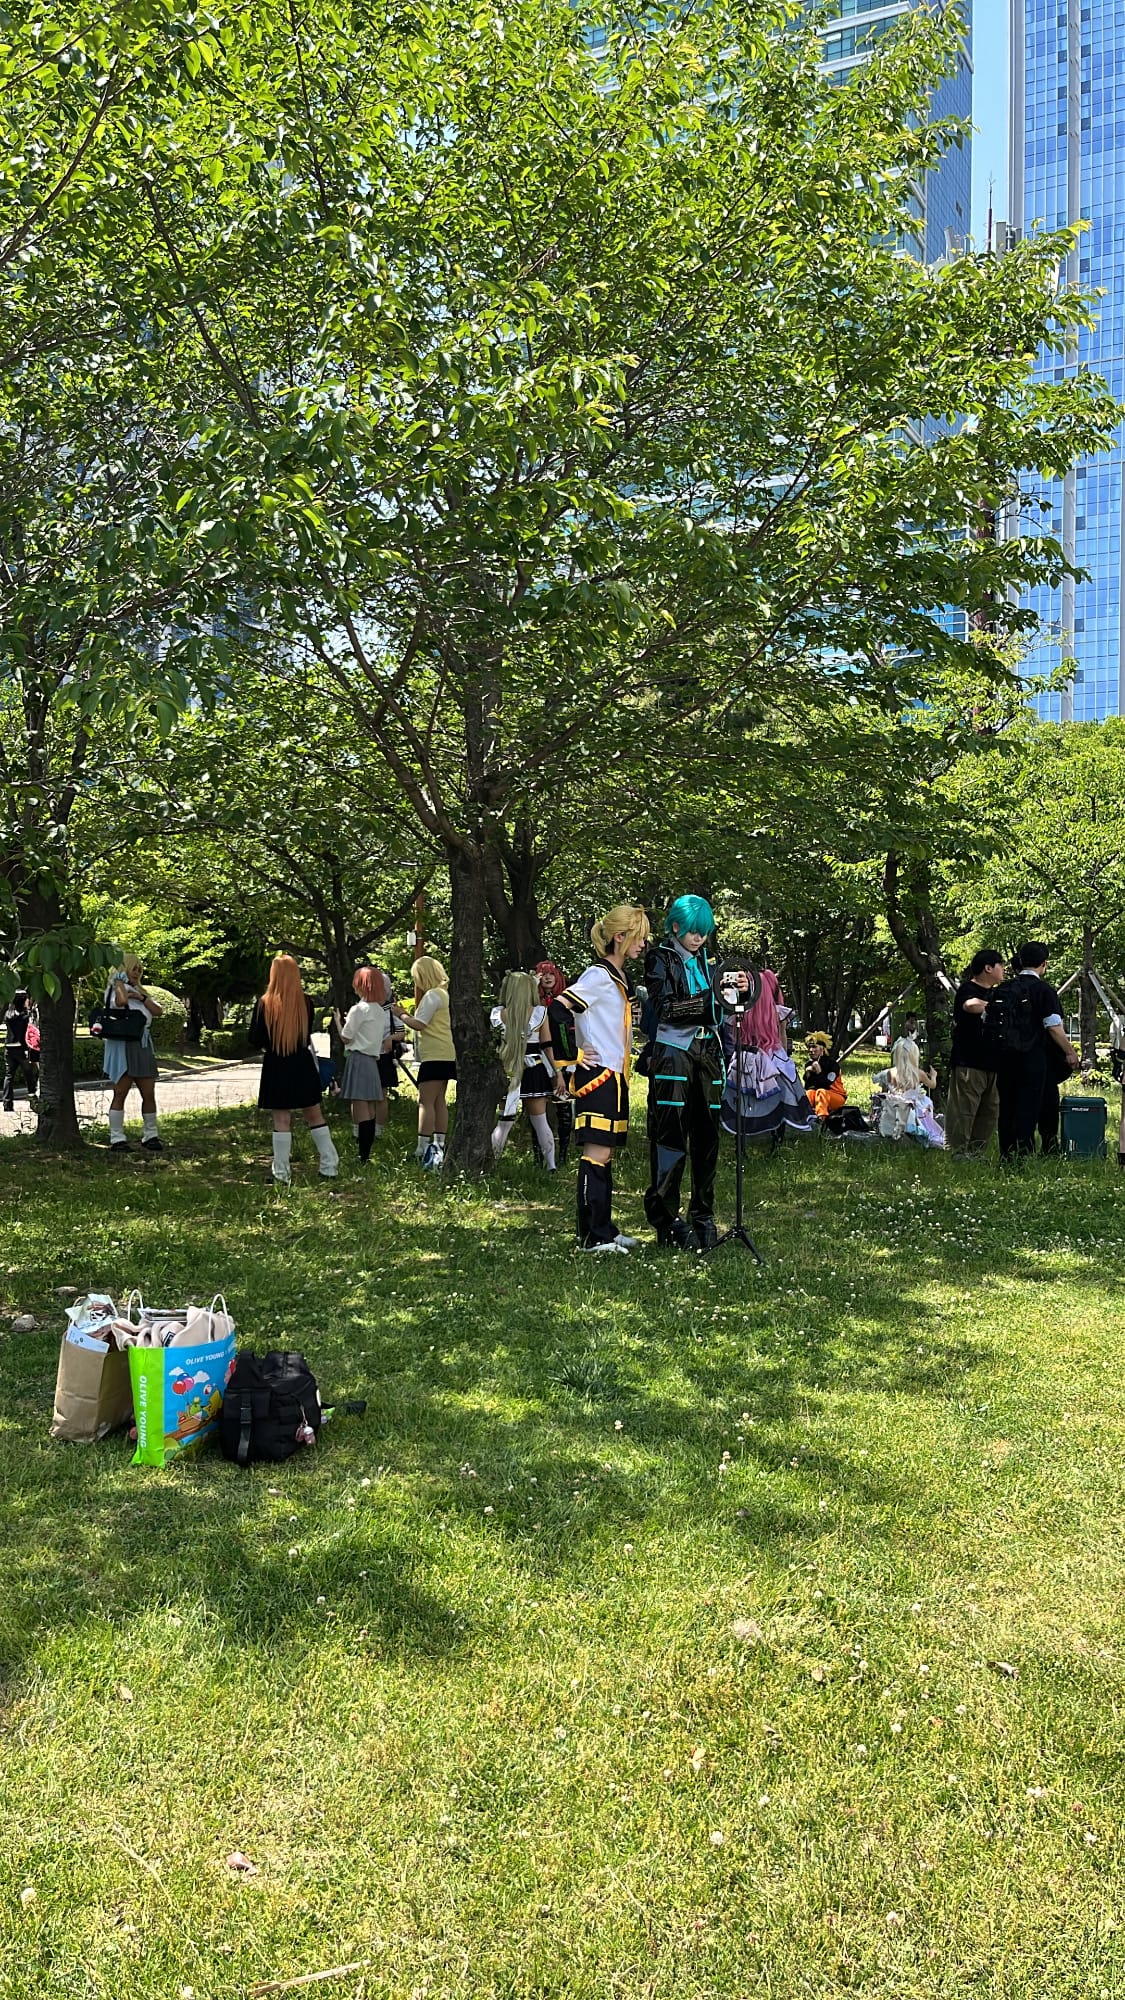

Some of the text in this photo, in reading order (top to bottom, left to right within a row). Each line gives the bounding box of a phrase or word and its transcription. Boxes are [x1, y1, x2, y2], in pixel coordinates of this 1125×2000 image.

[185, 1351, 225, 1365] OLIVE YOUNG
[139, 1375, 147, 1449] OLIVE YOUNG
